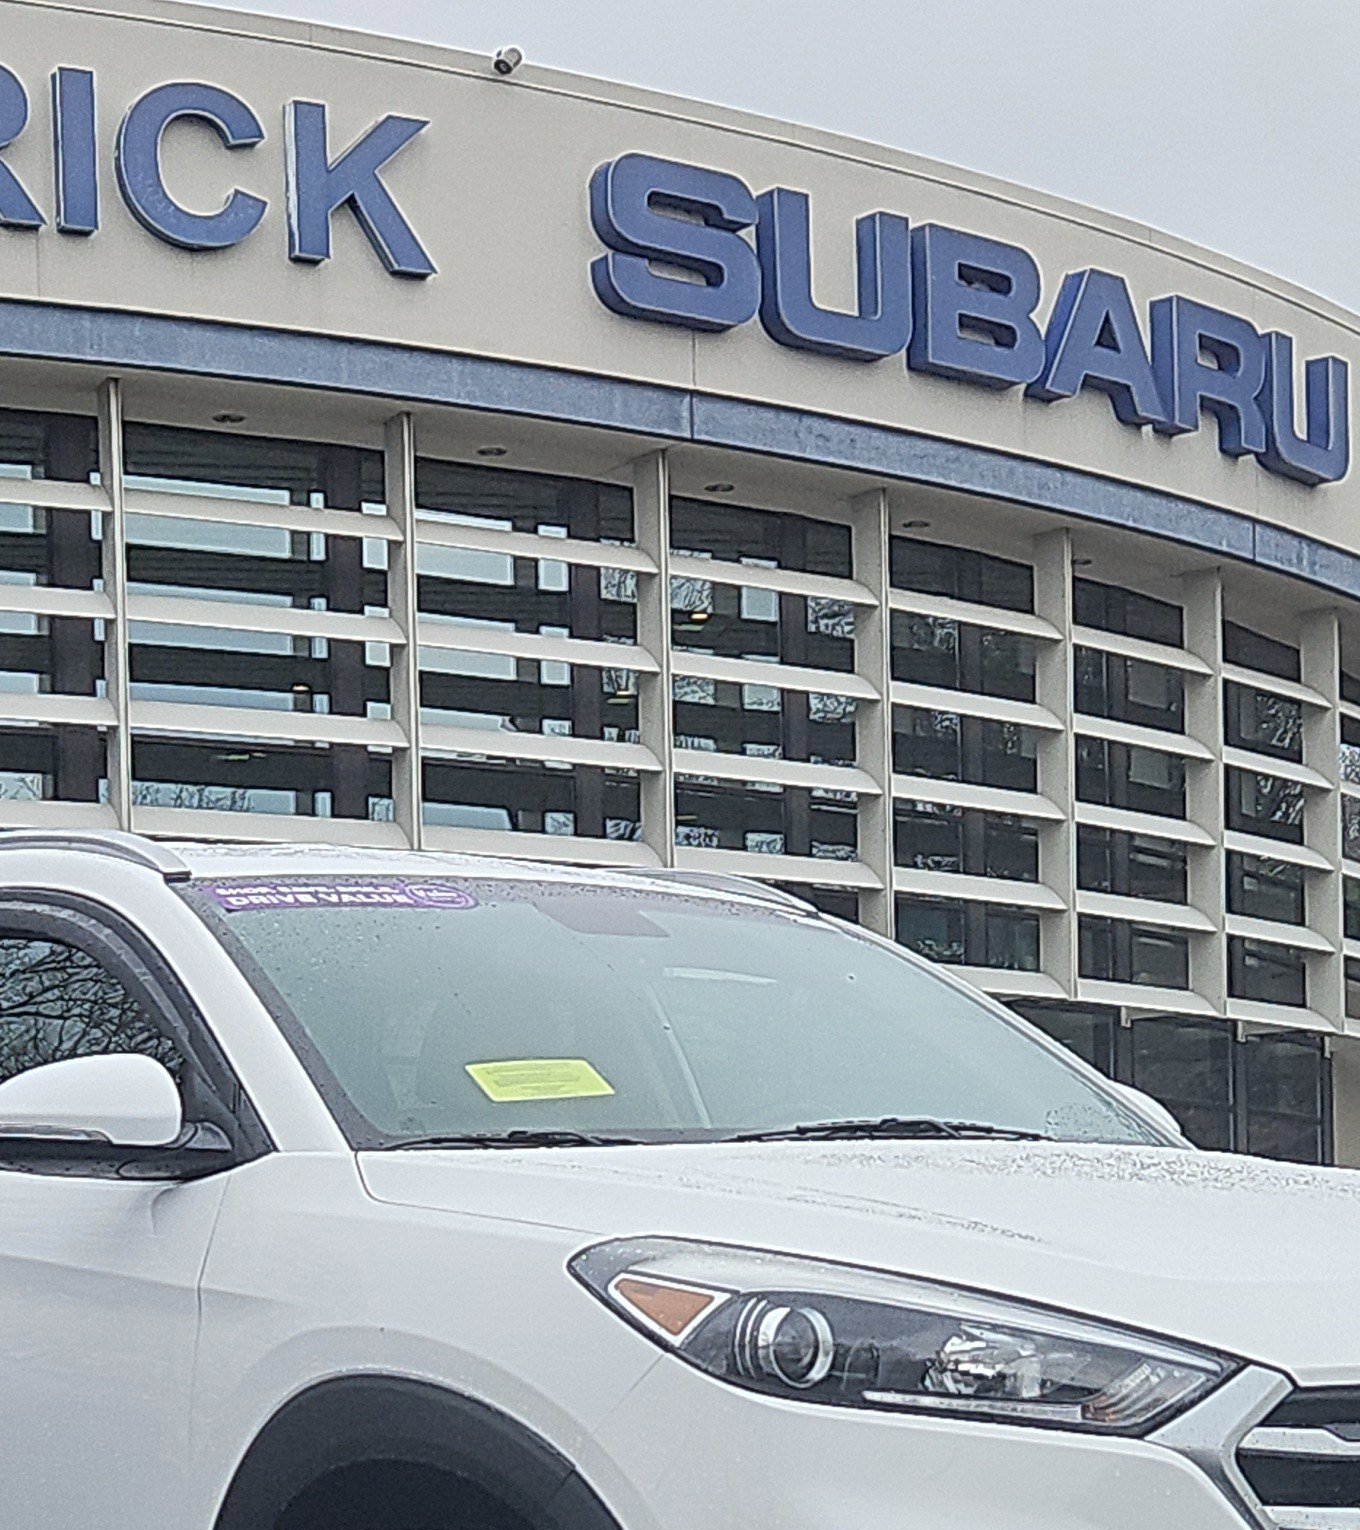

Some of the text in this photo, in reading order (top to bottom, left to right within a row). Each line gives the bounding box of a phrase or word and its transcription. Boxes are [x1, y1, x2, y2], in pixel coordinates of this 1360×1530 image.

[589, 152, 1349, 487] SUBARU
[227, 893, 317, 906] DRIVE
[317, 893, 415, 905] VALUE
